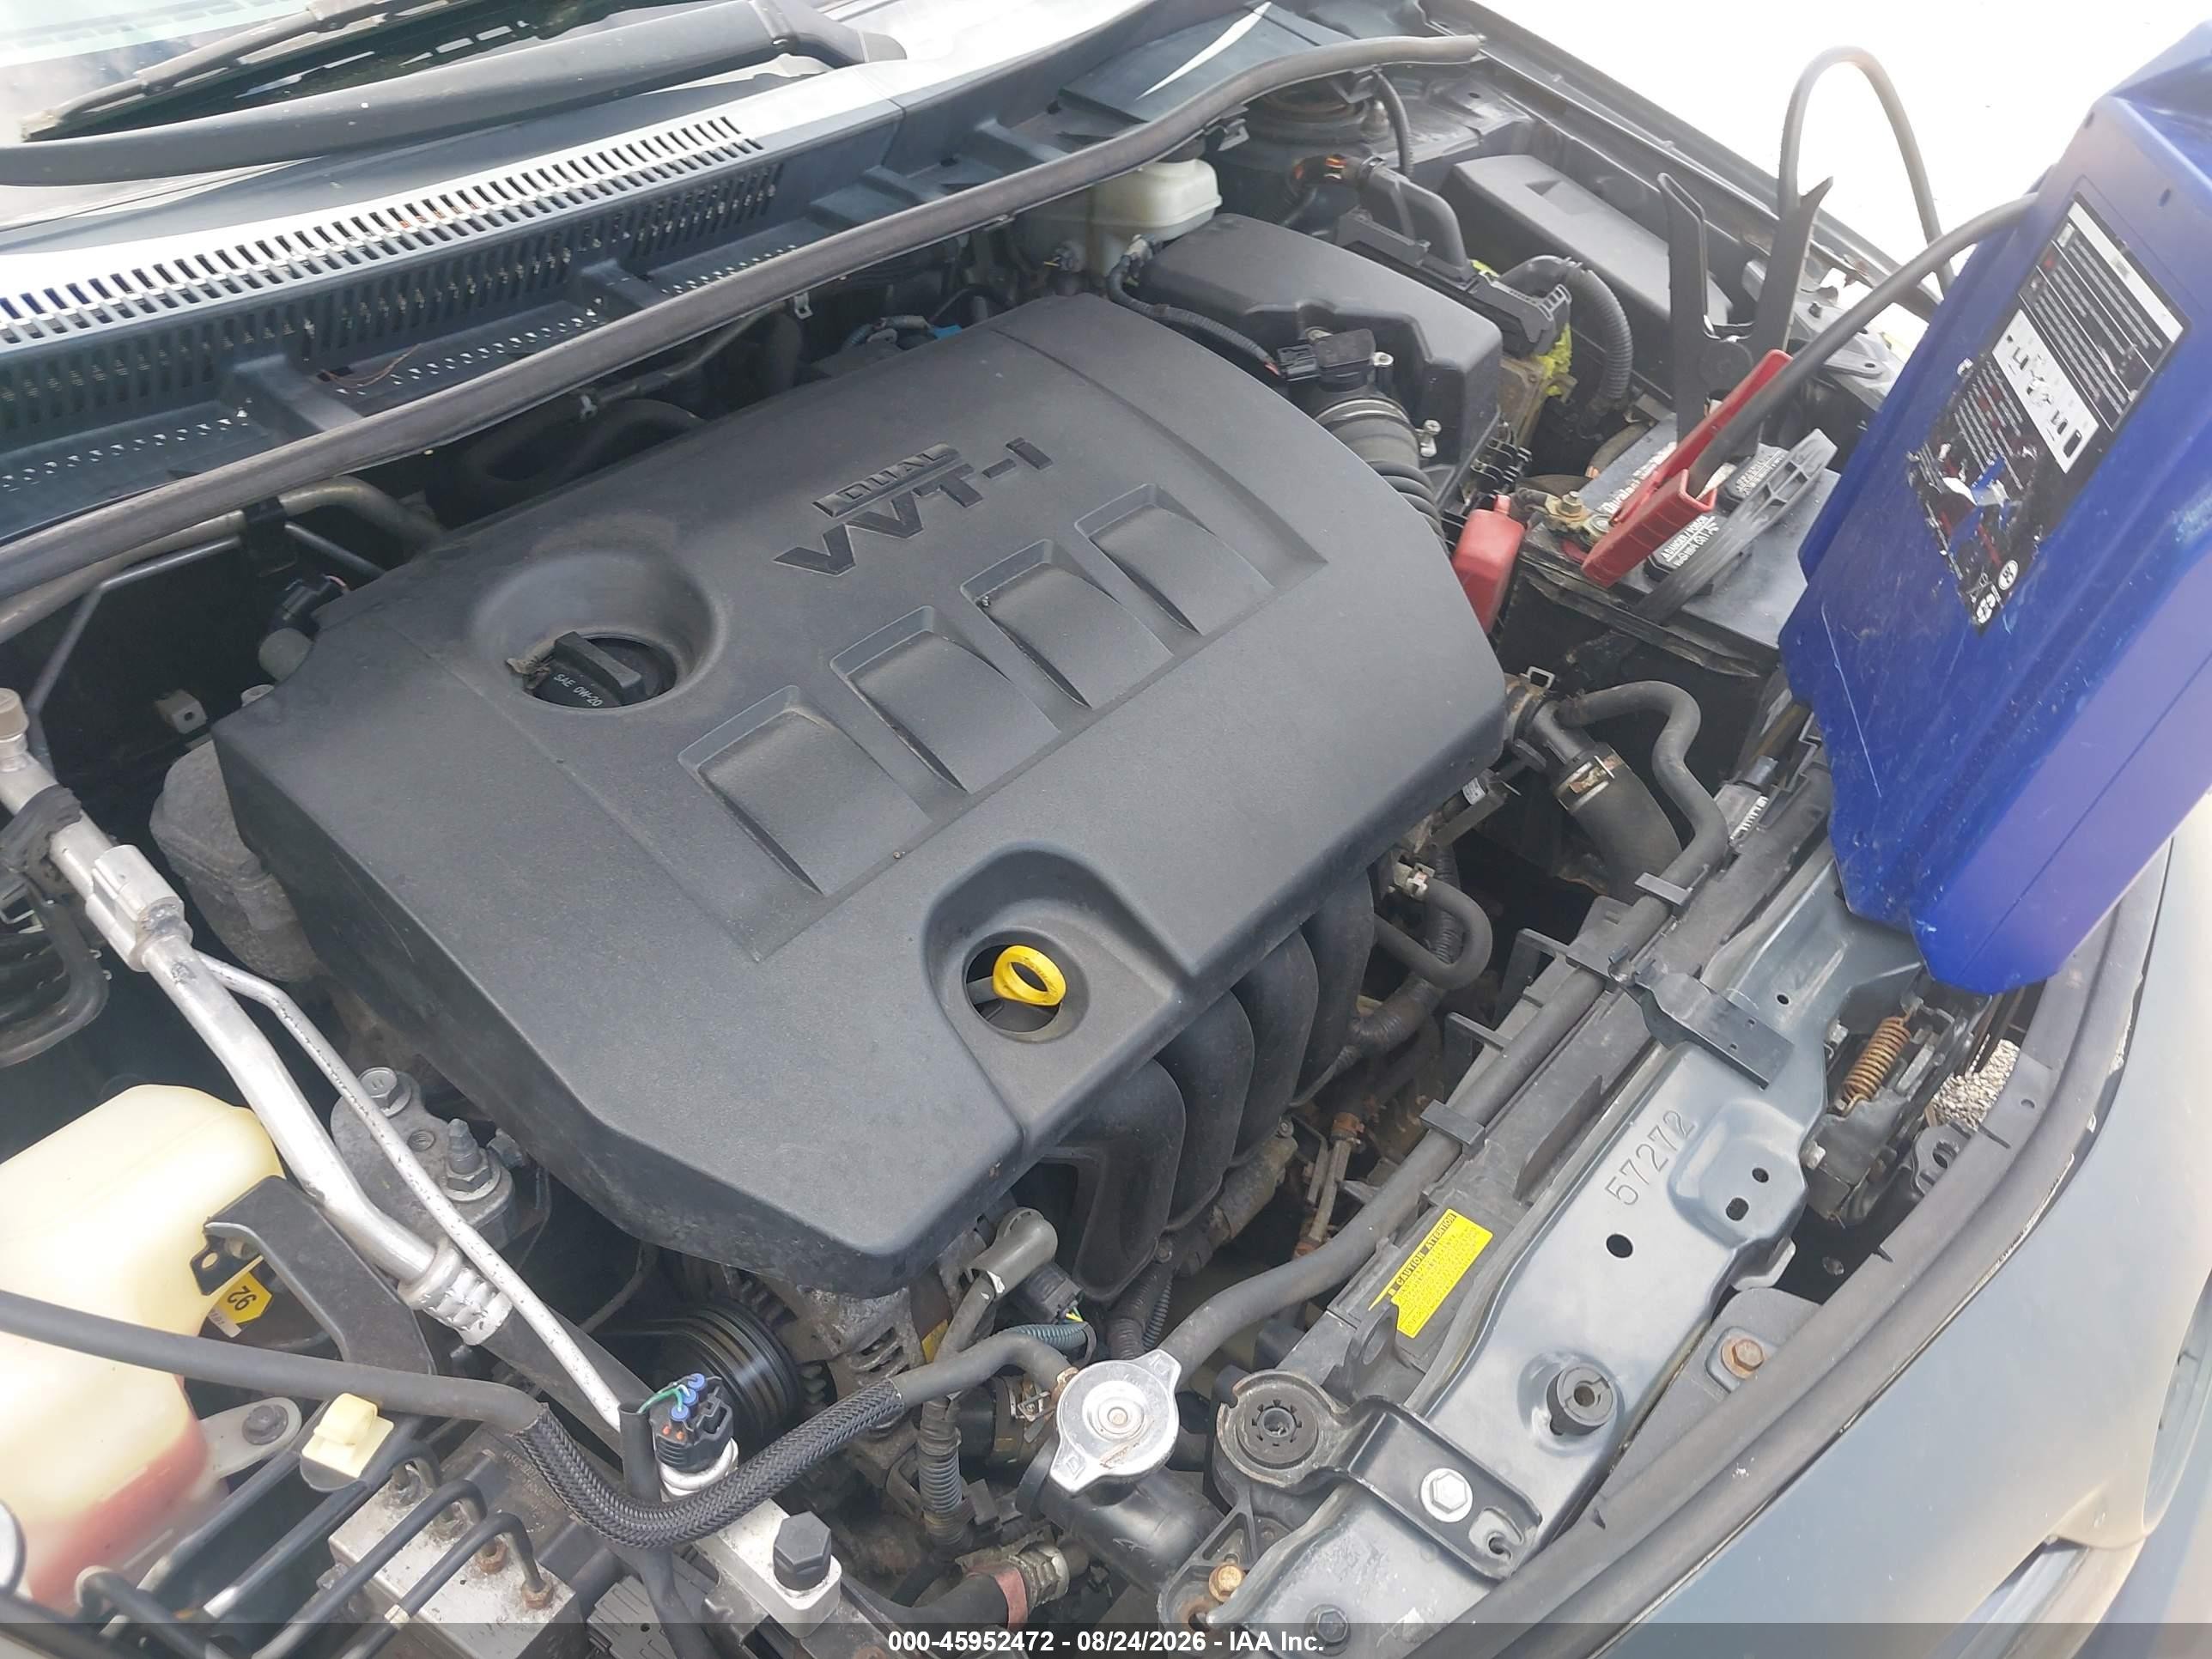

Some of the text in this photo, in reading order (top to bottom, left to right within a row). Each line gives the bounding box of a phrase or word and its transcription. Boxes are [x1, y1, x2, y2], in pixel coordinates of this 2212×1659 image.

[841, 452, 949, 500] DUAL
[553, 673, 604, 707] SAE 0W-20
[1604, 1109, 1697, 1206] 57272
[1395, 1251, 1426, 1286] CAUTION
[1426, 1212, 1457, 1251] ATTENTION
[227, 1285, 258, 1311] 92
